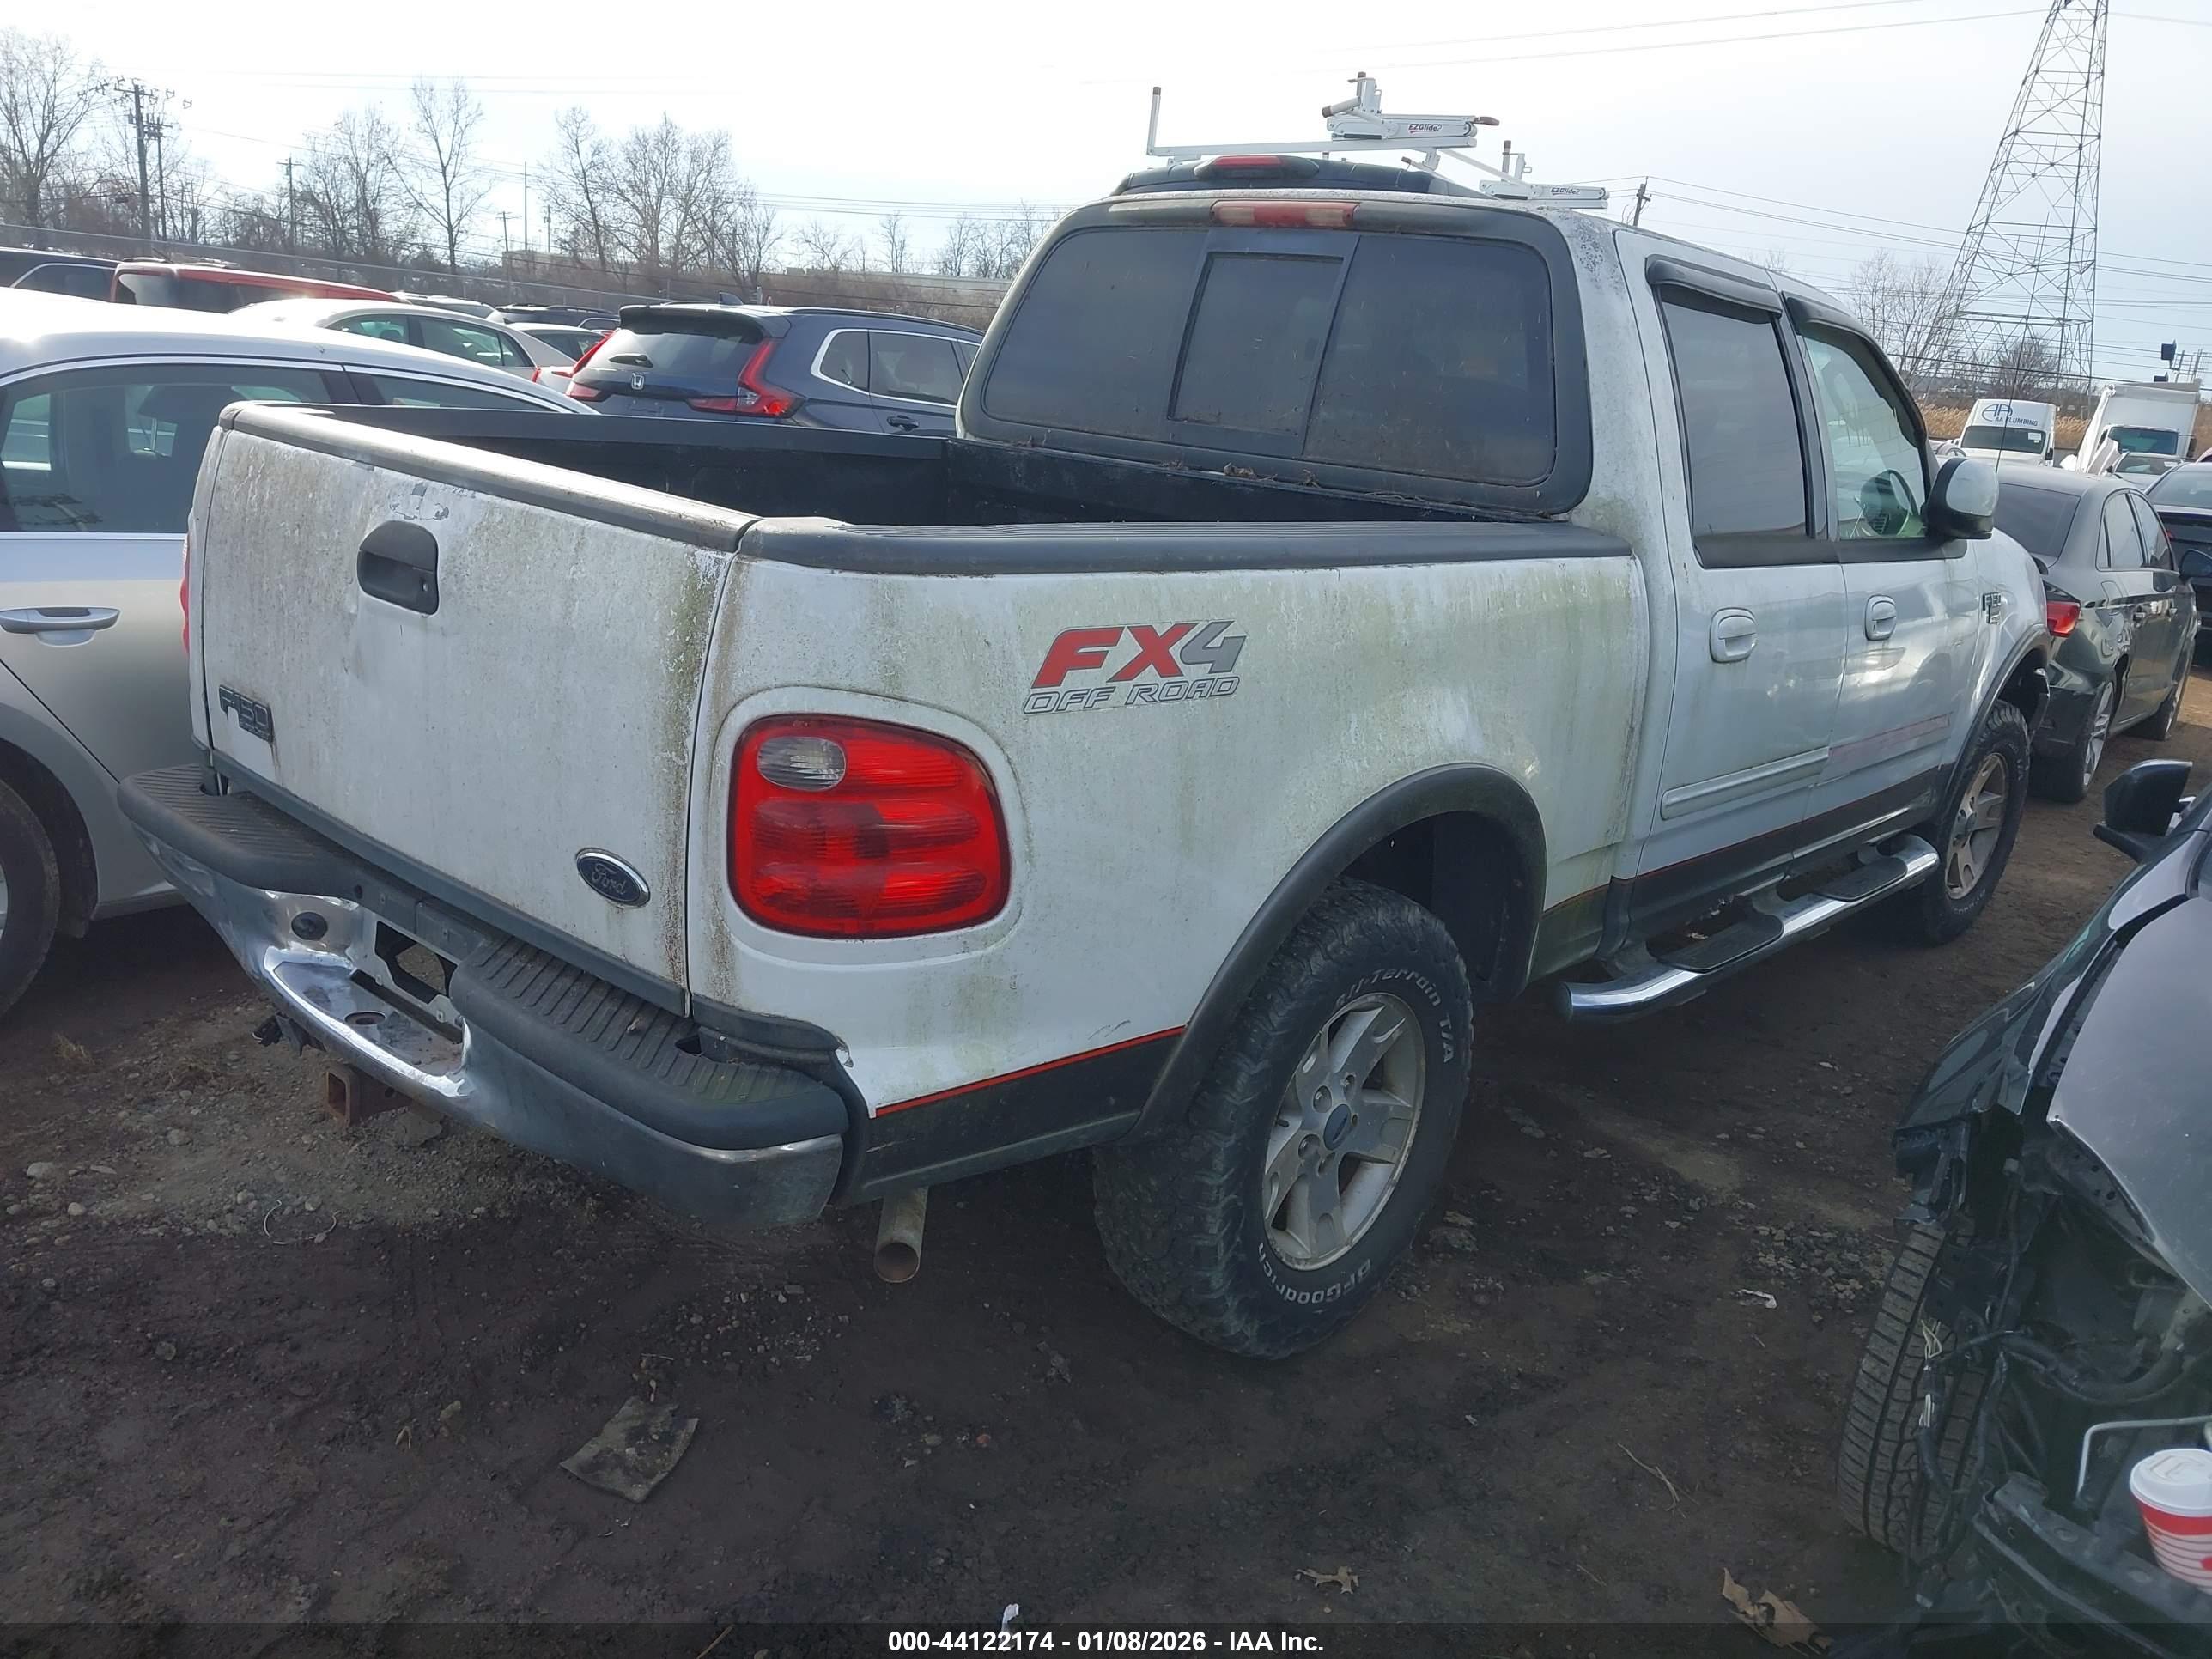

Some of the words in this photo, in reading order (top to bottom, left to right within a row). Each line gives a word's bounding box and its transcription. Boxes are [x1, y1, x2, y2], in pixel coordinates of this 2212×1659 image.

[1031, 620, 1247, 690] FX4
[1023, 686, 1117, 714] OFF
[1124, 677, 1241, 706] ROAD
[591, 862, 628, 895] Ford
